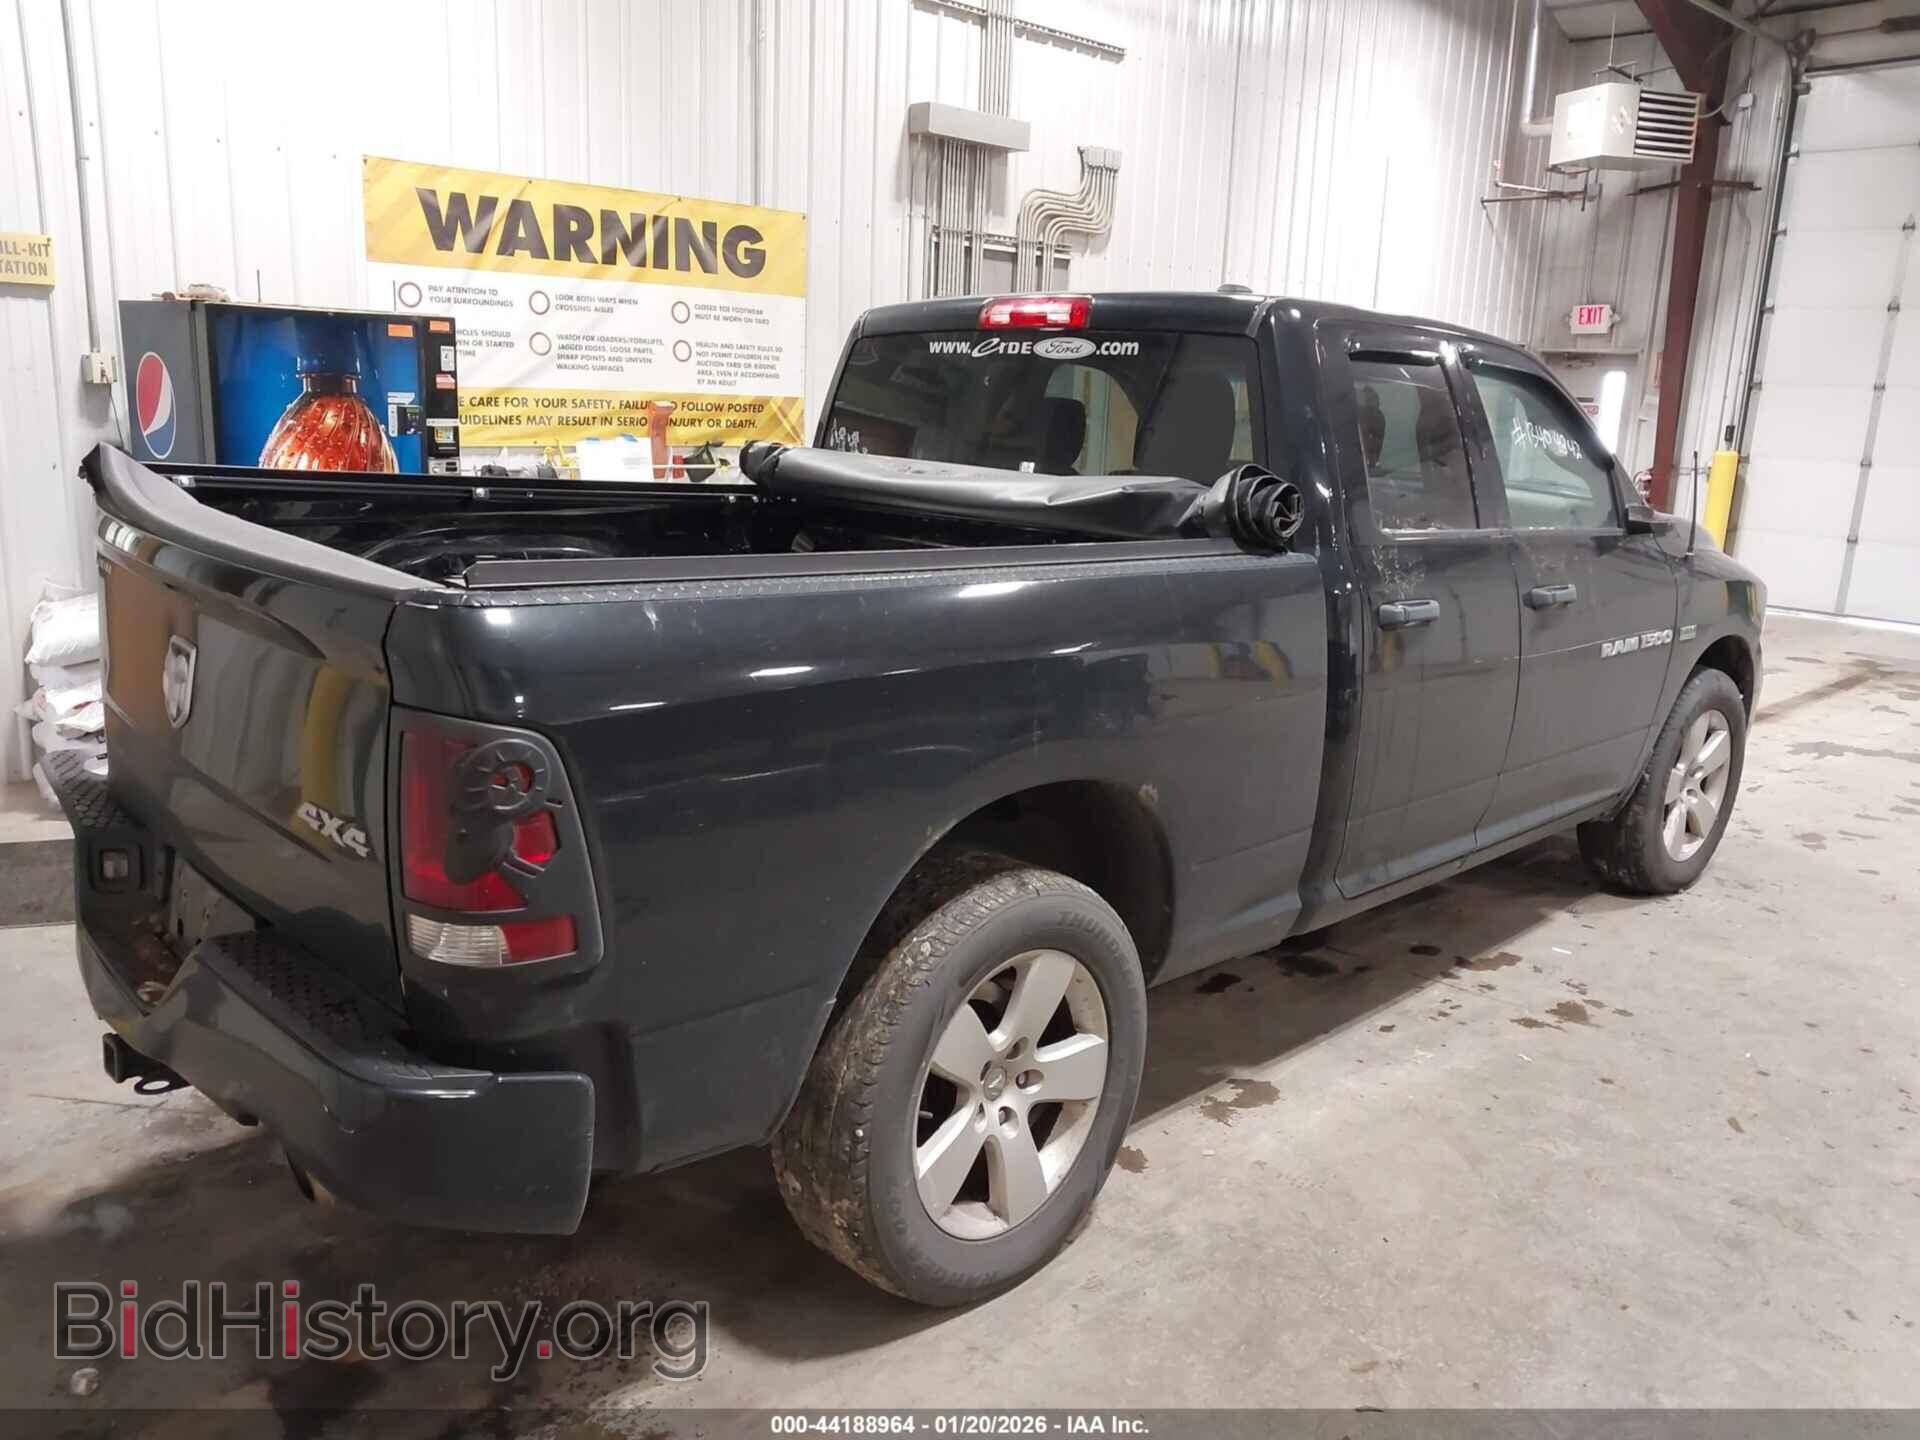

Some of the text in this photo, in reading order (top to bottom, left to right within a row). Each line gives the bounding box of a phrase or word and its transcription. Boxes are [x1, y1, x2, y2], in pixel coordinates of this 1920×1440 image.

[416, 187, 767, 279] WARNING
[0, 240, 50, 257] ILL-KIT
[446, 286, 487, 295] ATTENTION
[488, 288, 498, 296] TO
[429, 296, 514, 307] YOUR SURROUNDINGS
[576, 295, 595, 303] BOTH
[555, 304, 591, 312] CROSSING
[1578, 306, 1604, 325] EXIT
[556, 334, 580, 342] WATCH
[556, 362, 624, 372] WALKING SURFACES
[469, 397, 499, 407] CARE
[504, 397, 528, 408] FOR
[534, 398, 567, 408] YOUR
[572, 399, 615, 410] SAFETY.
[620, 400, 648, 410] FAILU
[681, 401, 724, 412] FOLLOW
[728, 404, 764, 413] POSTED
[460, 414, 522, 425] UIDELINES
[526, 415, 552, 426] MAY
[558, 416, 596, 426] RESULT
[600, 416, 613, 426] IN
[617, 416, 648, 426] SERIO
[706, 418, 722, 428] OR
[726, 419, 758, 428] DEATH.
[1601, 636, 1639, 658] RAM
[1641, 629, 1673, 649] 1500
